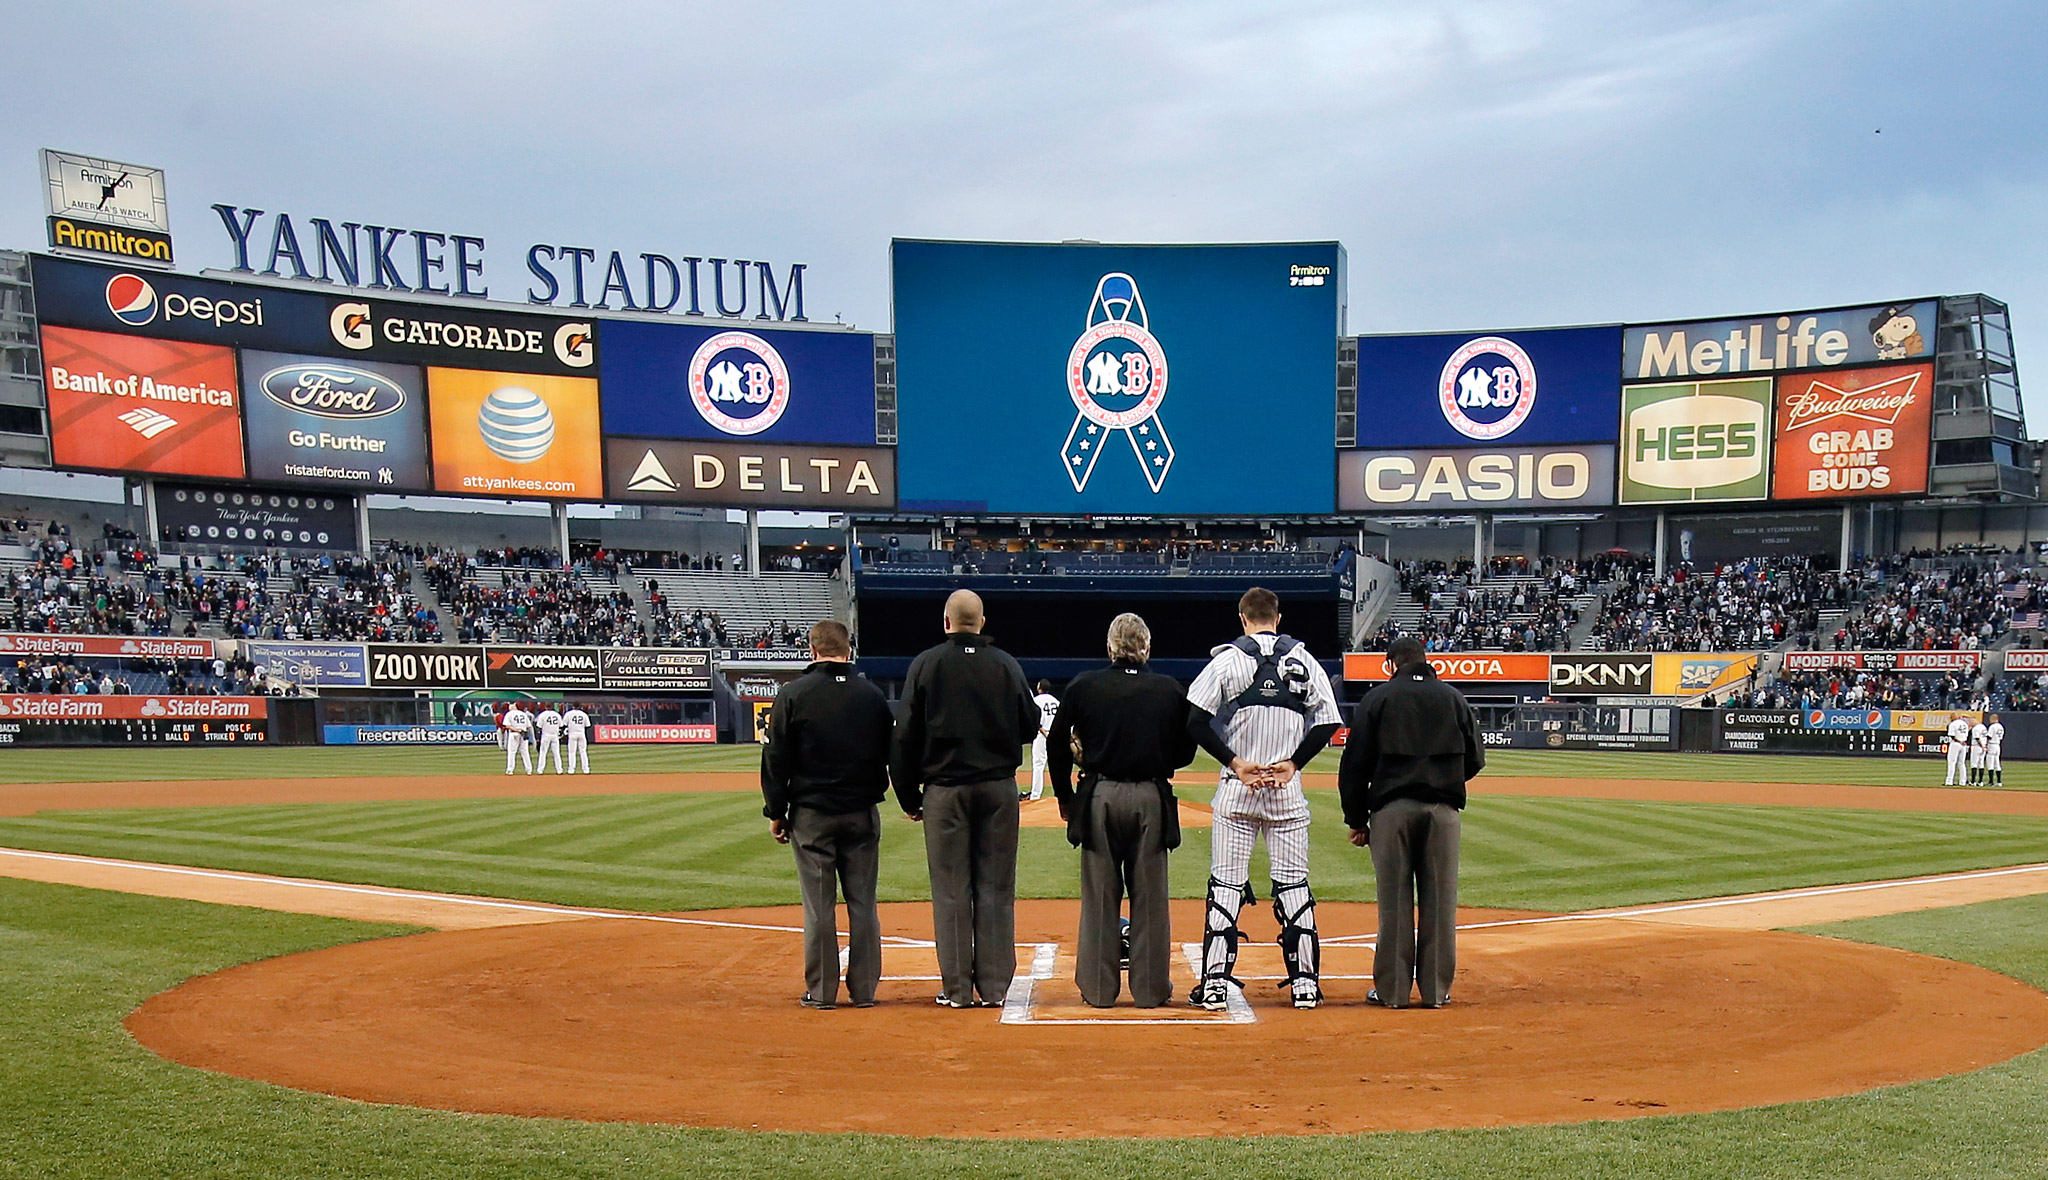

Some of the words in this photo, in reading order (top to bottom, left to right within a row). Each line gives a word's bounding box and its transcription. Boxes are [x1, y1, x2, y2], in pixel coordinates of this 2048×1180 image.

[120, 208, 150, 220] WATCH
[55, 220, 173, 260] Armitron
[211, 203, 489, 299] YANKEE
[526, 244, 808, 323] STADIUM
[1290, 264, 1331, 276] Armitron
[164, 293, 264, 328] pepsi
[383, 318, 544, 354] GATORADE
[1638, 316, 1849, 378] MetLife
[51, 367, 112, 396] Bank
[114, 374, 138, 397] of
[141, 376, 233, 407] America
[290, 369, 378, 413] Ford
[1785, 390, 1915, 419] Budweiser
[289, 430, 317, 449] Go
[319, 432, 386, 453] Further
[1636, 423, 1756, 462] HESS
[1808, 428, 1894, 455] GRAB
[1821, 451, 1878, 468] SOME
[285, 463, 370, 481] tristateford.com
[693, 454, 880, 494] DELTA
[1364, 452, 1590, 503] CASIO
[1808, 466, 1891, 492] BUDS
[463, 475, 576, 493] att.yankees.com
[216, 508, 239, 520] New
[239, 509, 262, 525] York
[263, 511, 300, 526] Yankees
[339, 649, 361, 658] Center
[604, 651, 649, 668] Yankees
[657, 655, 706, 665] STEINER
[1904, 654, 1975, 668] MODELL'S
[374, 653, 417, 680] ZOO
[420, 655, 481, 681] YORK
[618, 666, 694, 675] COLLECTIBLES
[1428, 659, 1504, 675] OYOTA
[1551, 664, 1651, 686] DKNY
[1682, 665, 1721, 684] SAP
[534, 676, 596, 684] yokohamatire.com
[604, 679, 708, 688] STEINERSPORTS.COM
[736, 683, 780, 696] Peanut
[1043, 702, 1058, 716] 42
[513, 714, 525, 724] 42
[546, 715, 559, 725] 42
[571, 715, 584, 725] 42
[1738, 714, 1785, 724] GATORADE
[1830, 713, 1862, 726] pepsi
[172, 724, 181, 732] AT
[182, 724, 195, 732] BAT
[225, 724, 239, 732] POS
[611, 728, 659, 739] DUNKIN'
[660, 728, 711, 740] DONUTS
[165, 733, 182, 742] BALL
[183, 733, 189, 742] 0
[205, 733, 228, 742] STRIKE
[228, 733, 235, 742] 0
[243, 733, 257, 742] OUT
[257, 733, 264, 742] 0
[1889, 735, 1898, 743] AT
[1899, 735, 1911, 743] BAT
[1729, 741, 1758, 749] YANKEES
[1882, 743, 1898, 752] BALL
[1918, 744, 1941, 752] STRIKE
[1941, 744, 1948, 753] 0
